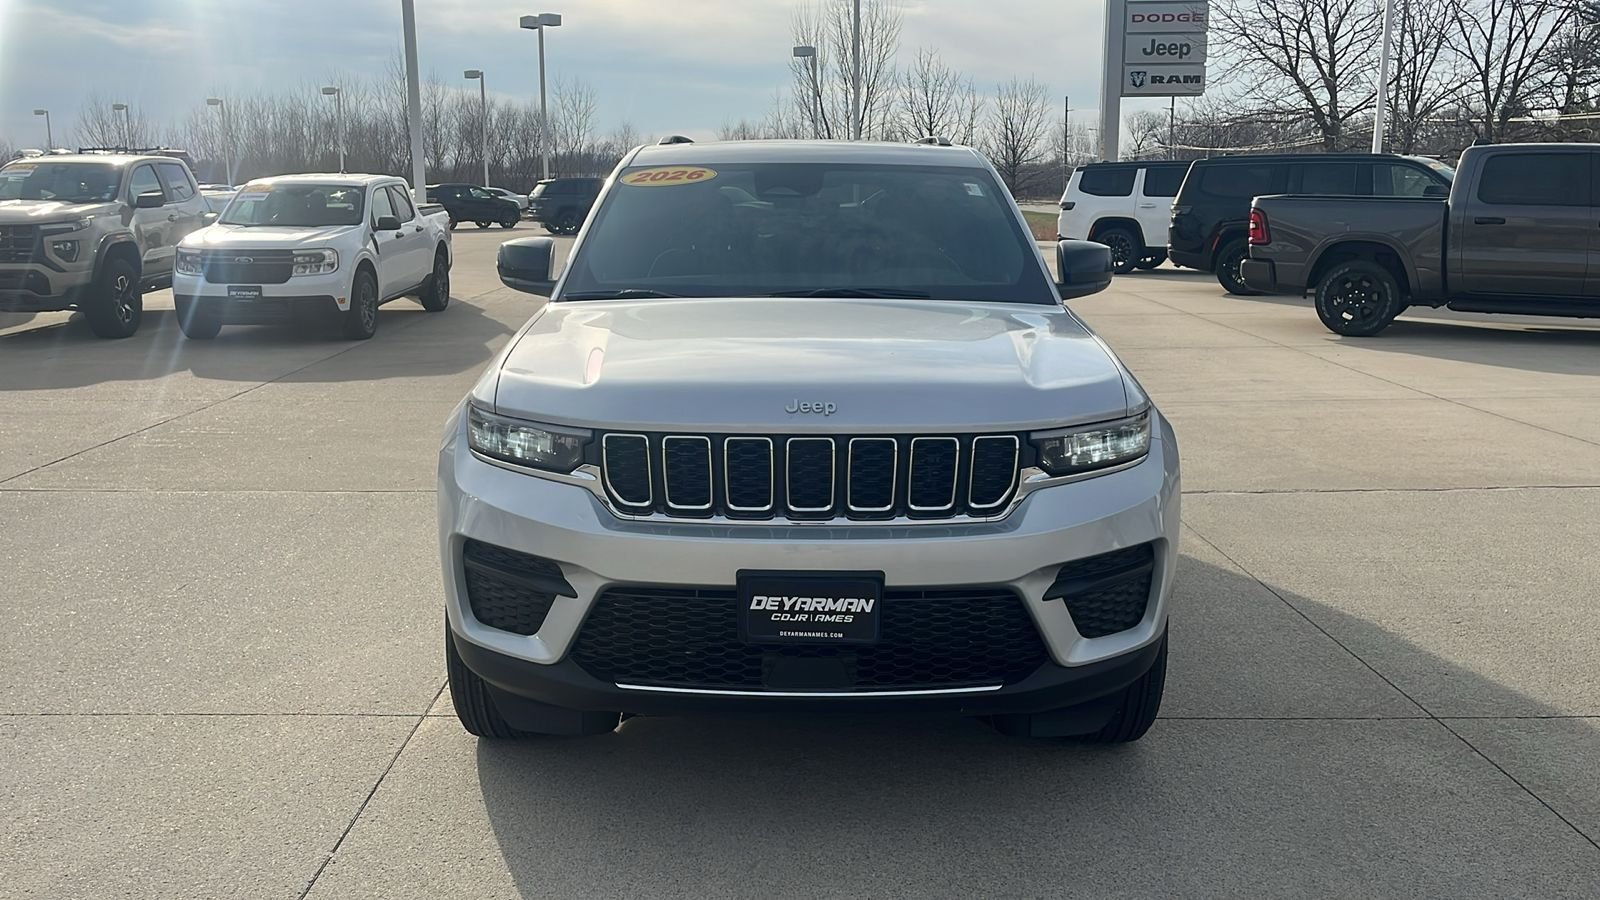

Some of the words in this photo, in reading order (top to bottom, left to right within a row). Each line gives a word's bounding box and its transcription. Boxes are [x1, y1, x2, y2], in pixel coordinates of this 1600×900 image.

[1131, 13, 1204, 23] DODGE
[1142, 38, 1191, 59] Jeep
[1150, 75, 1201, 84] RAM
[630, 170, 706, 183] 2026
[784, 399, 837, 416] Jeep
[750, 595, 875, 613] DEYARMAN
[814, 614, 854, 623] AMES
[779, 630, 844, 638] DEYARMANAMES.COM
